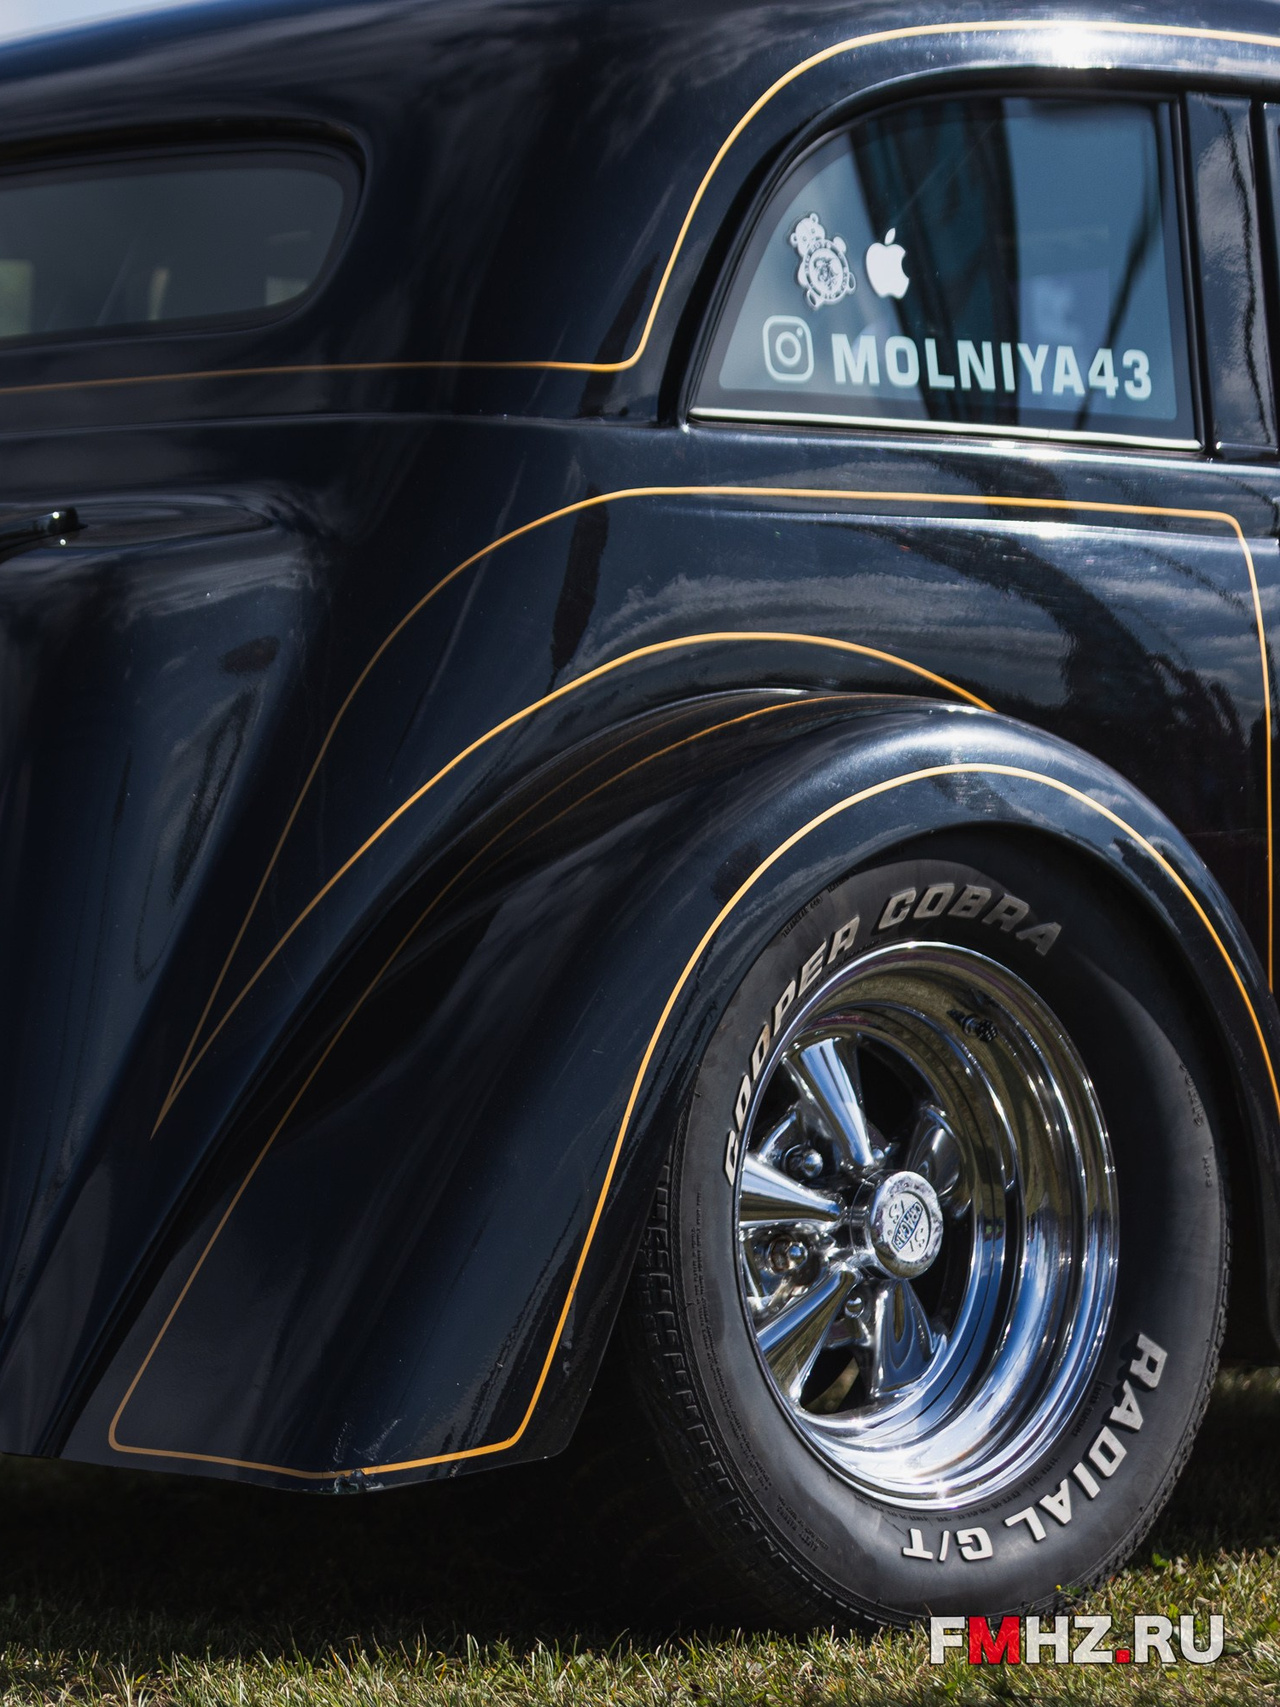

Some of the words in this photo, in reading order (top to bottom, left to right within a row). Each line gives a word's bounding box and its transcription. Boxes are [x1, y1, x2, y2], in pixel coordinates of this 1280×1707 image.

[831, 333, 1152, 399] MOLNIYA43
[725, 916, 860, 1187] COOPER
[878, 883, 1063, 956] COBRA
[1006, 1333, 1168, 1541] RADIAL
[903, 1527, 993, 1562] G/T
